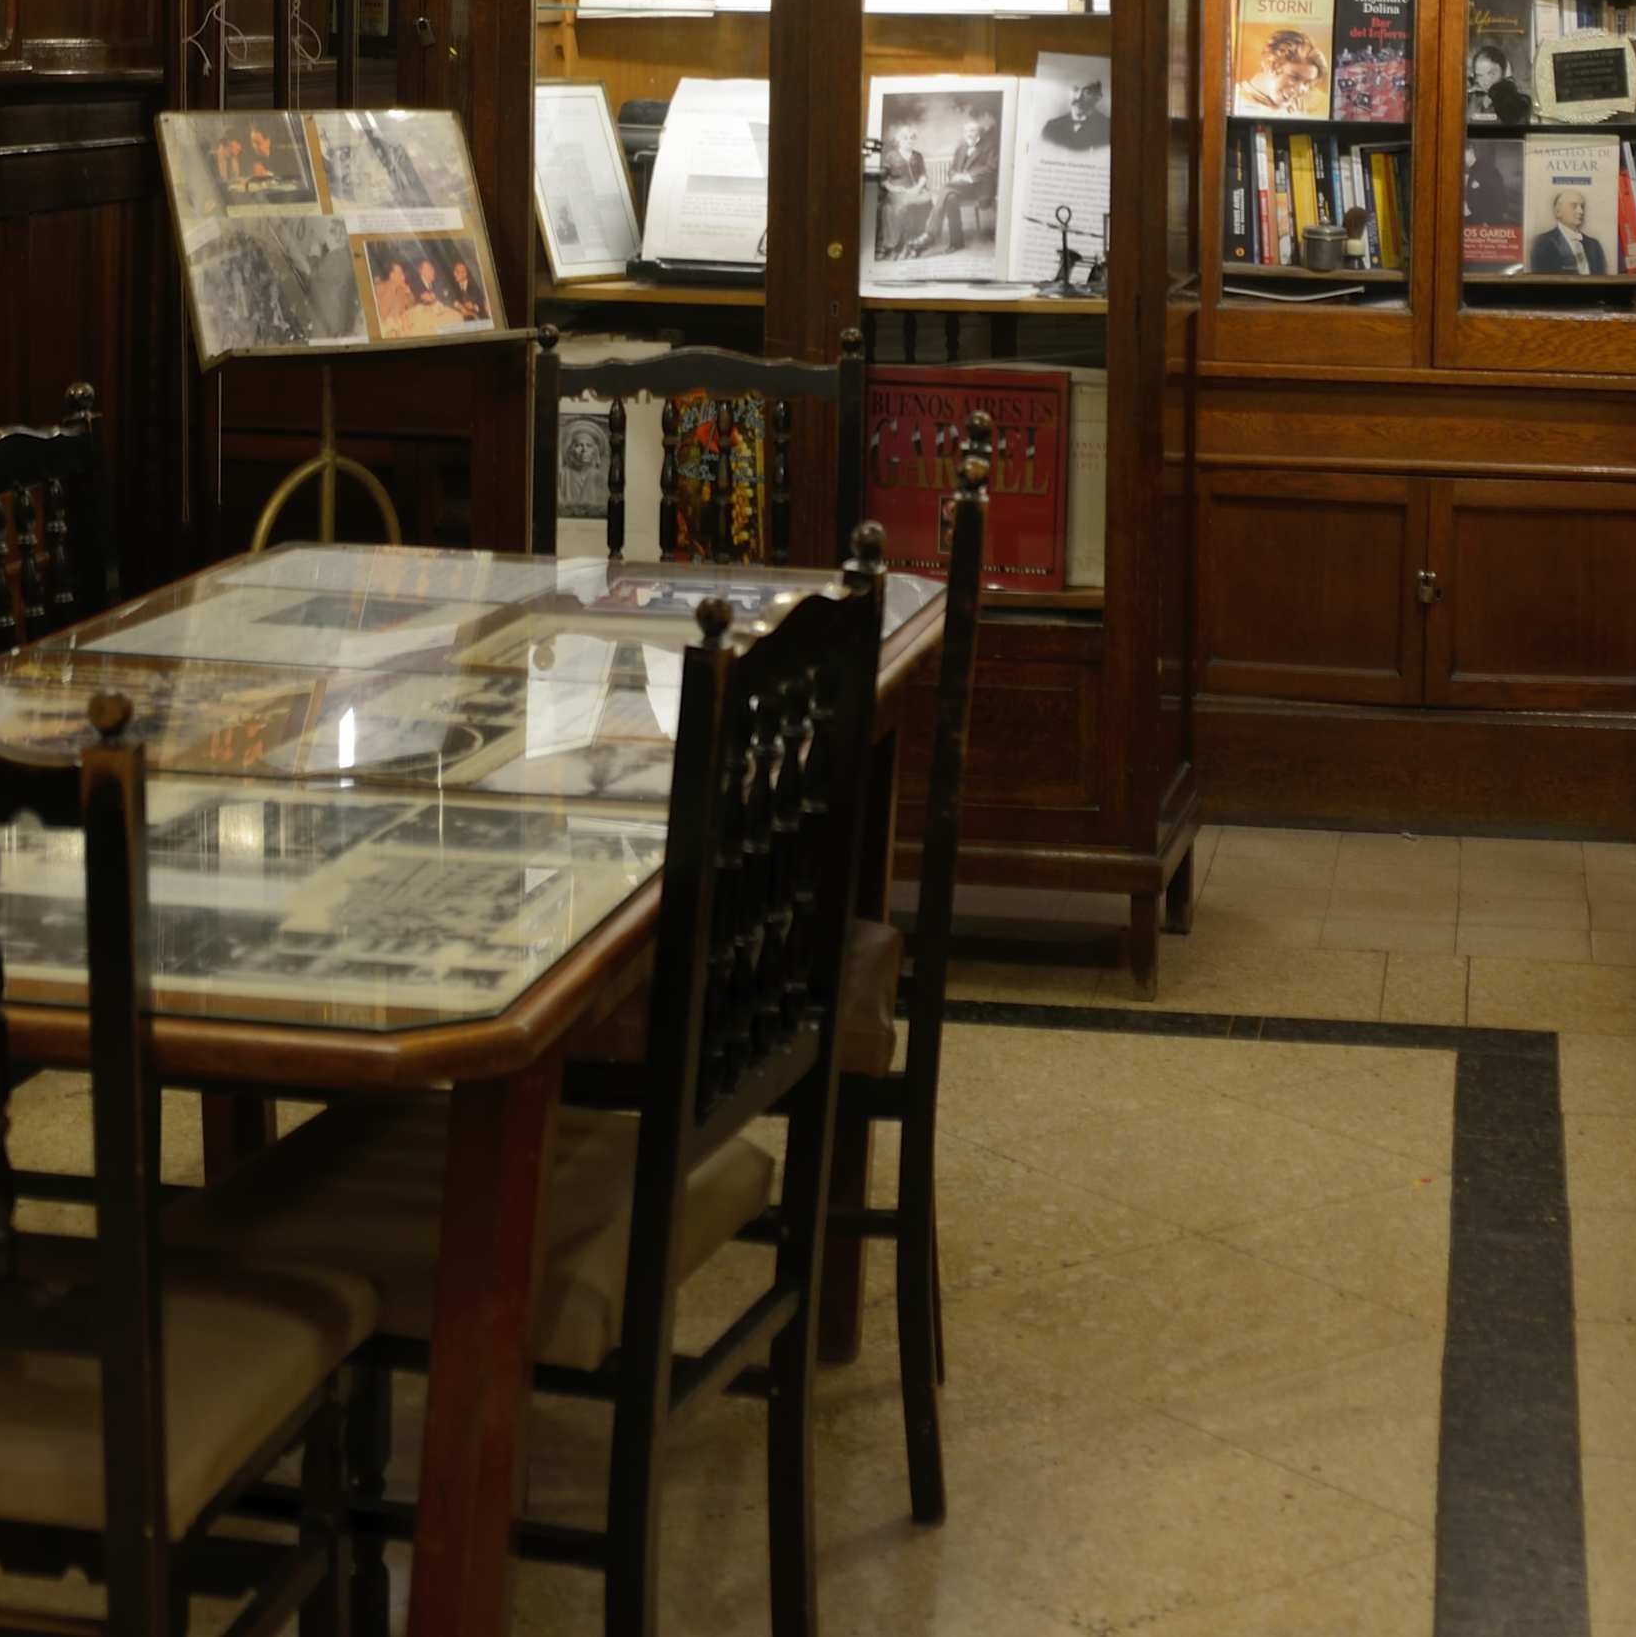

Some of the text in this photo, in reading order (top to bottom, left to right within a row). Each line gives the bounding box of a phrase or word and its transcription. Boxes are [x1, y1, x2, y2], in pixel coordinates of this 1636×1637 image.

[1257, 0, 1313, 13] STORNI
[1363, 3, 1400, 14] Dolina
[1368, 27, 1408, 39] Infiern
[1548, 160, 1599, 171] ALVEAR
[1479, 229, 1517, 239] GARDEL
[872, 391, 1054, 421] BUENOS AIRES ES
[869, 417, 1049, 494] GAREL
